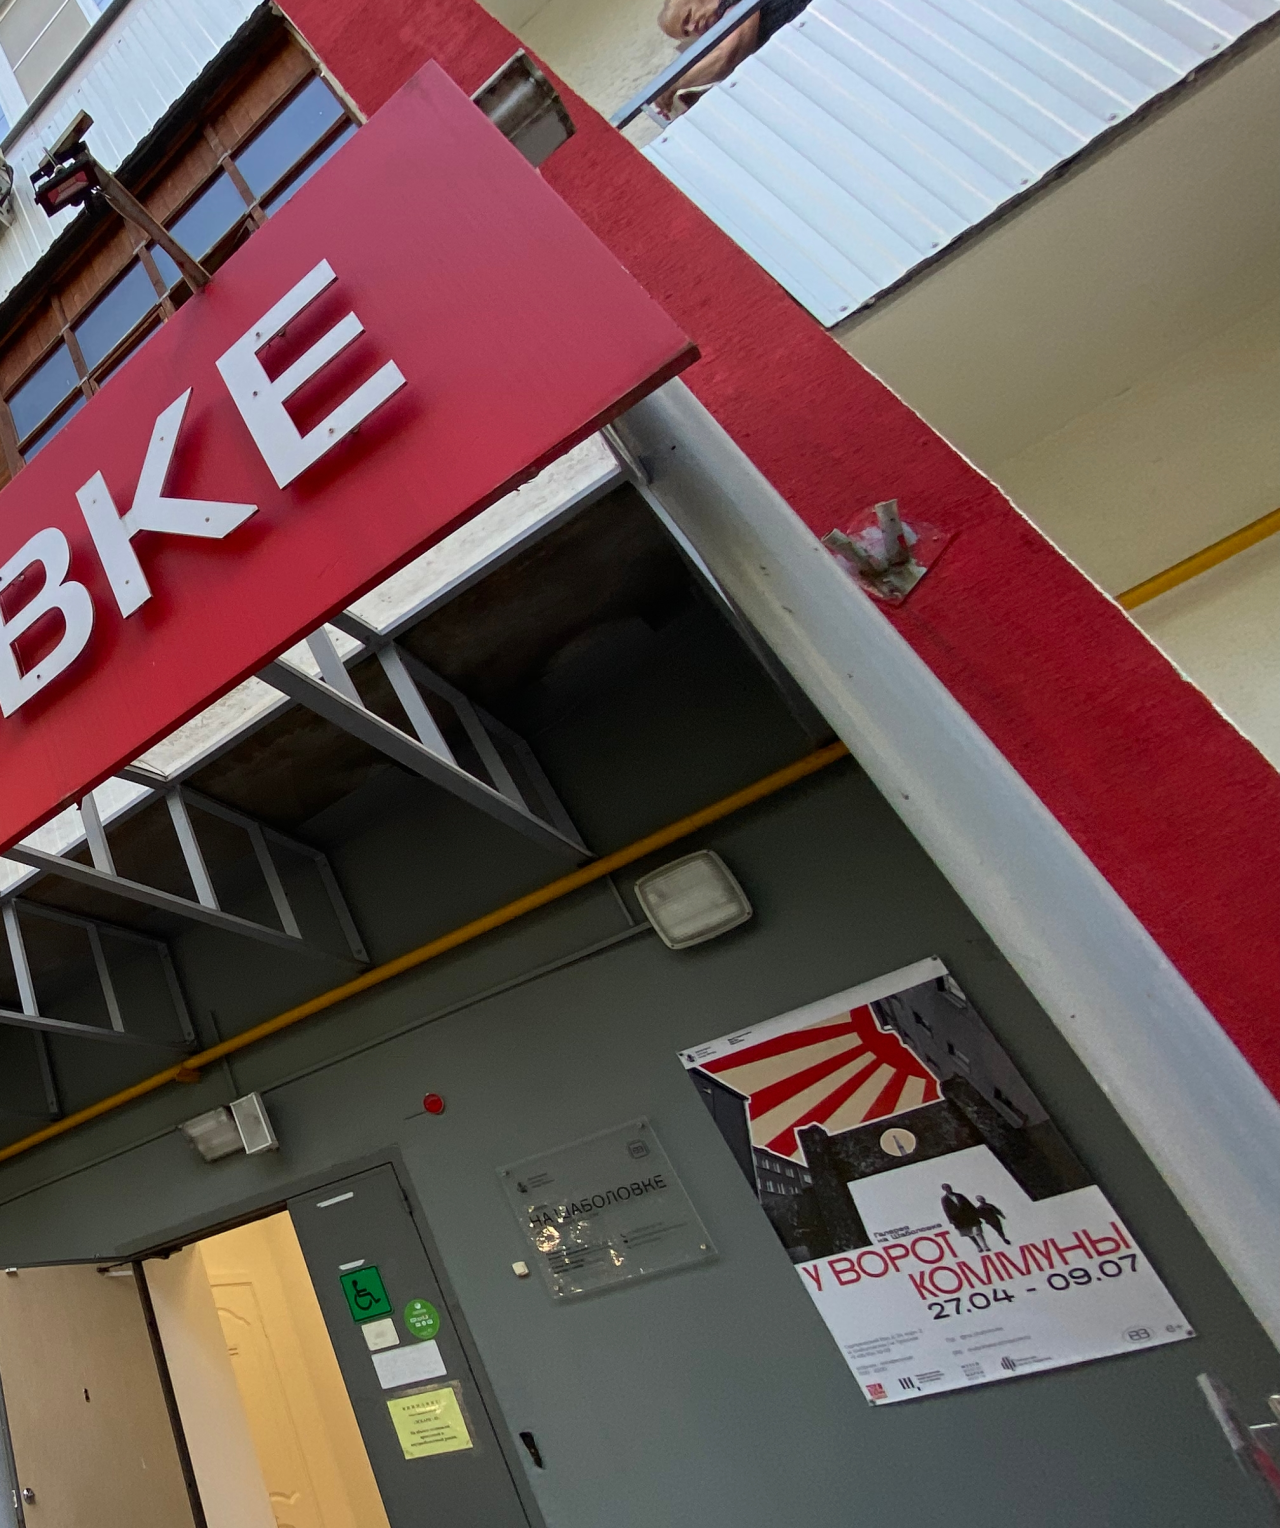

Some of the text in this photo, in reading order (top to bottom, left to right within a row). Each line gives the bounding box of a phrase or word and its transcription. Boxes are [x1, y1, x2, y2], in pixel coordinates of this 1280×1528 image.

[529, 1211, 554, 1228] НА
[802, 1230, 960, 1292] У ВОРОТ
[908, 1221, 1134, 1300] КОММУНЫ
[927, 1287, 1016, 1321] 27.04
[1046, 1253, 1139, 1292] 09.07
